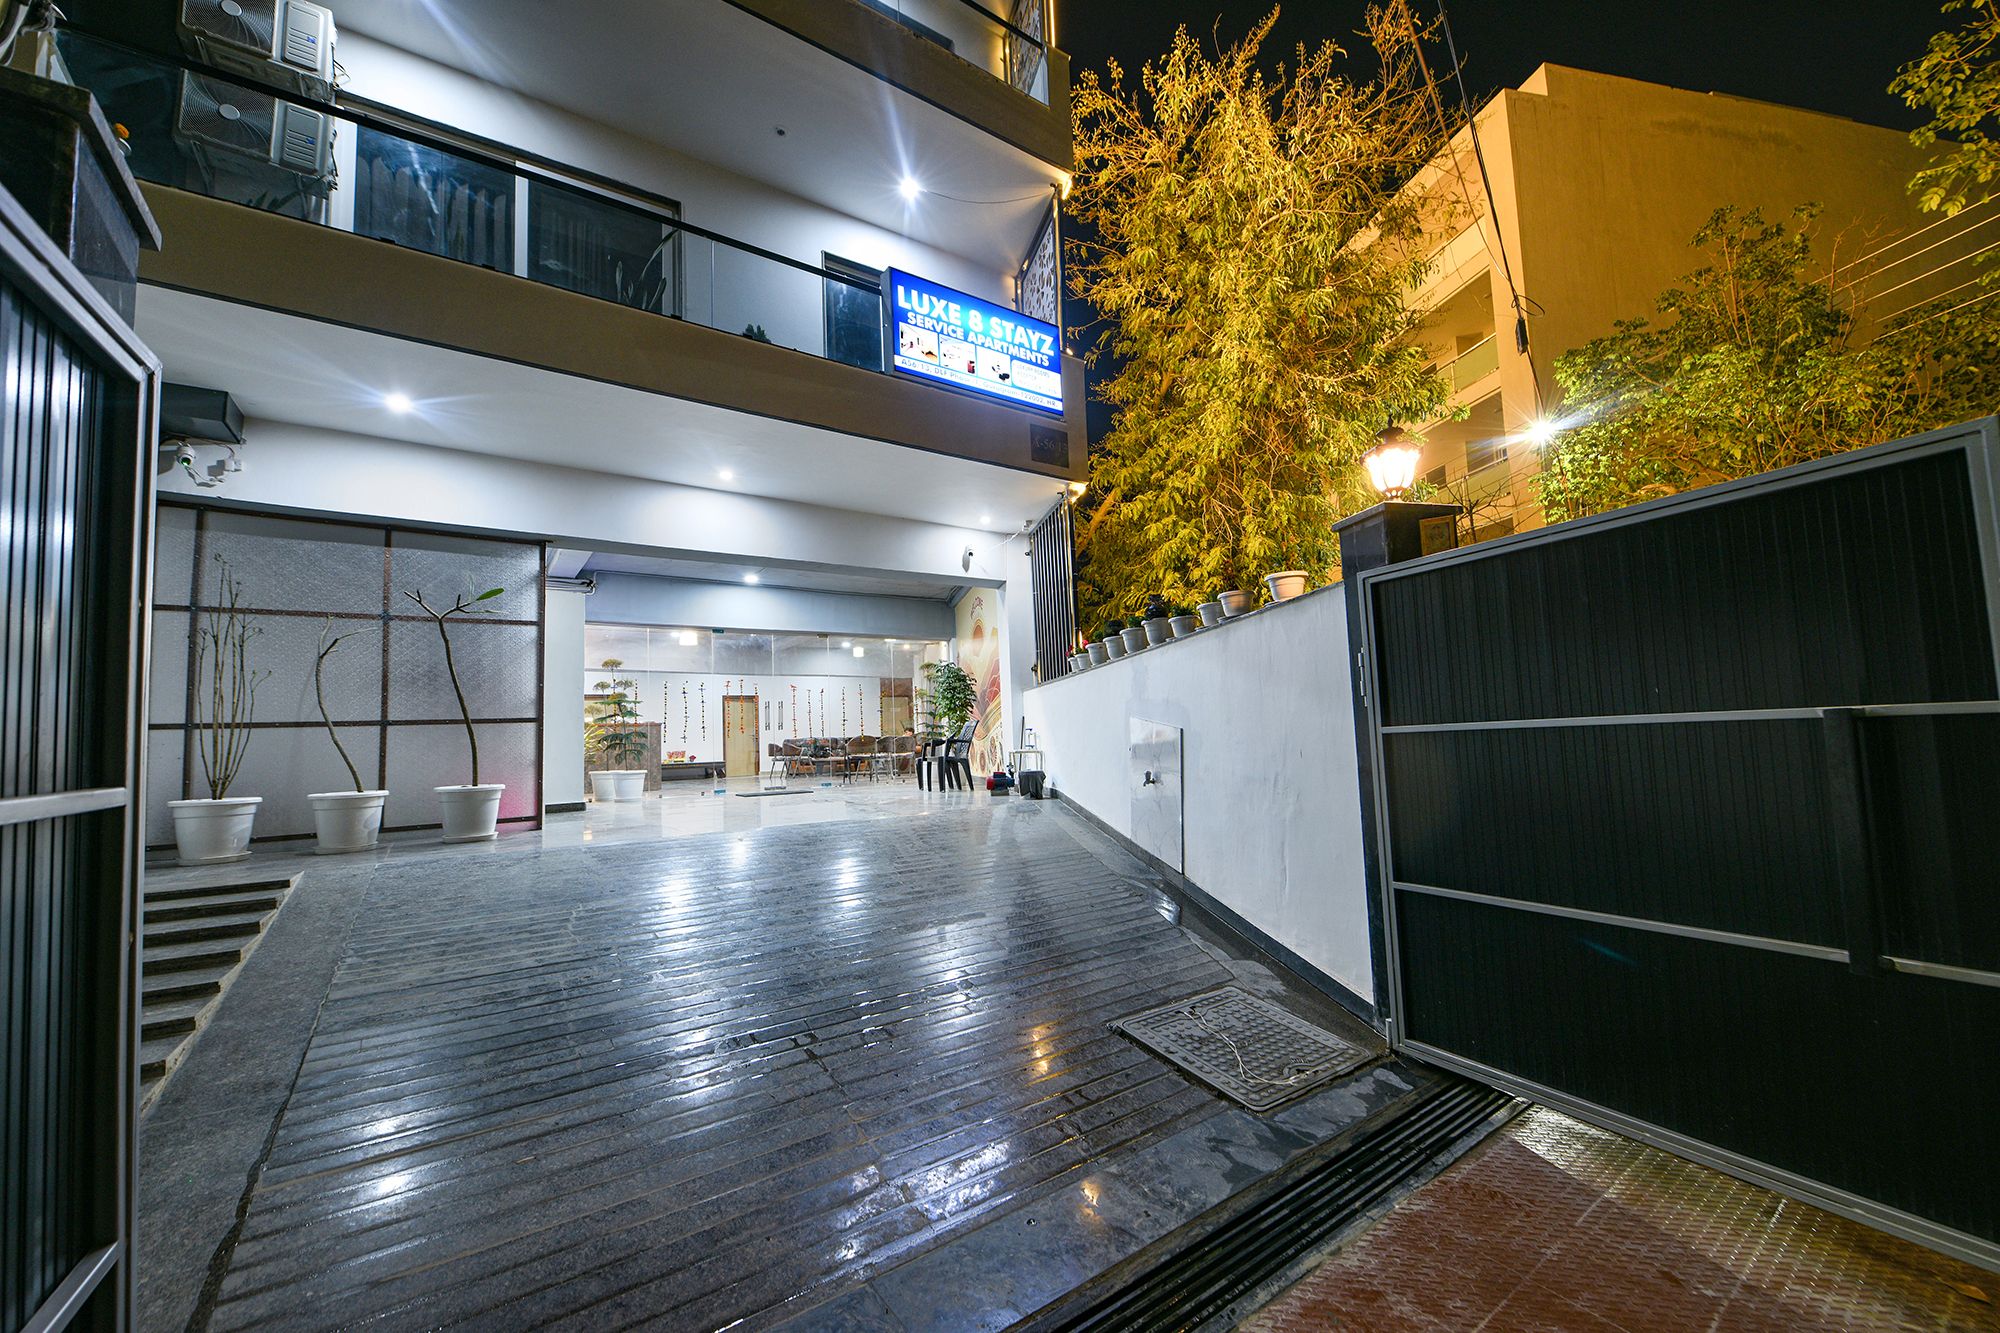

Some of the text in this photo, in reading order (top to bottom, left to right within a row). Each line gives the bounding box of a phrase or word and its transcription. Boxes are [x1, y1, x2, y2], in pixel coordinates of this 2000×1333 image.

[897, 284, 962, 327] LUXE
[989, 316, 1055, 357] STAYZ
[907, 311, 1050, 367] SERVICE APARTMENTS
